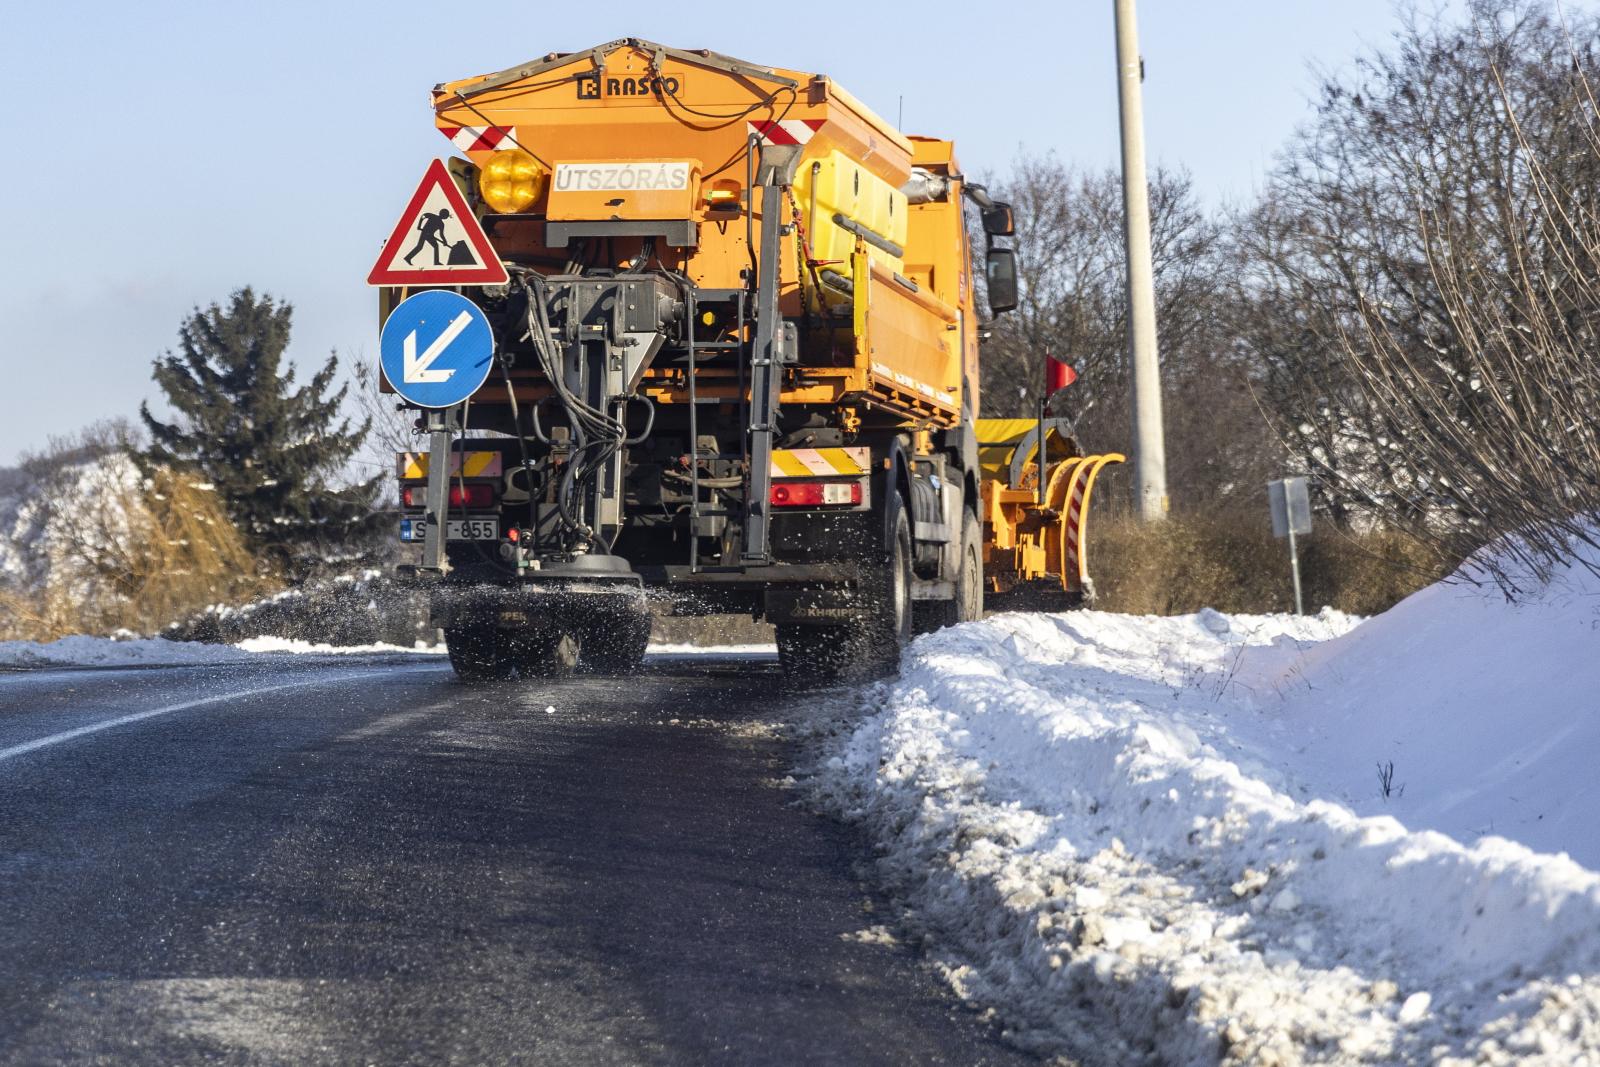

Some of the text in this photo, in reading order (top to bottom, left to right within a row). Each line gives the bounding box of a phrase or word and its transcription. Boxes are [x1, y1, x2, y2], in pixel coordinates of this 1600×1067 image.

[607, 78, 679, 96] RASCO
[556, 164, 686, 190] ÚTSZÓRÁS
[415, 522, 493, 538] ST-855
